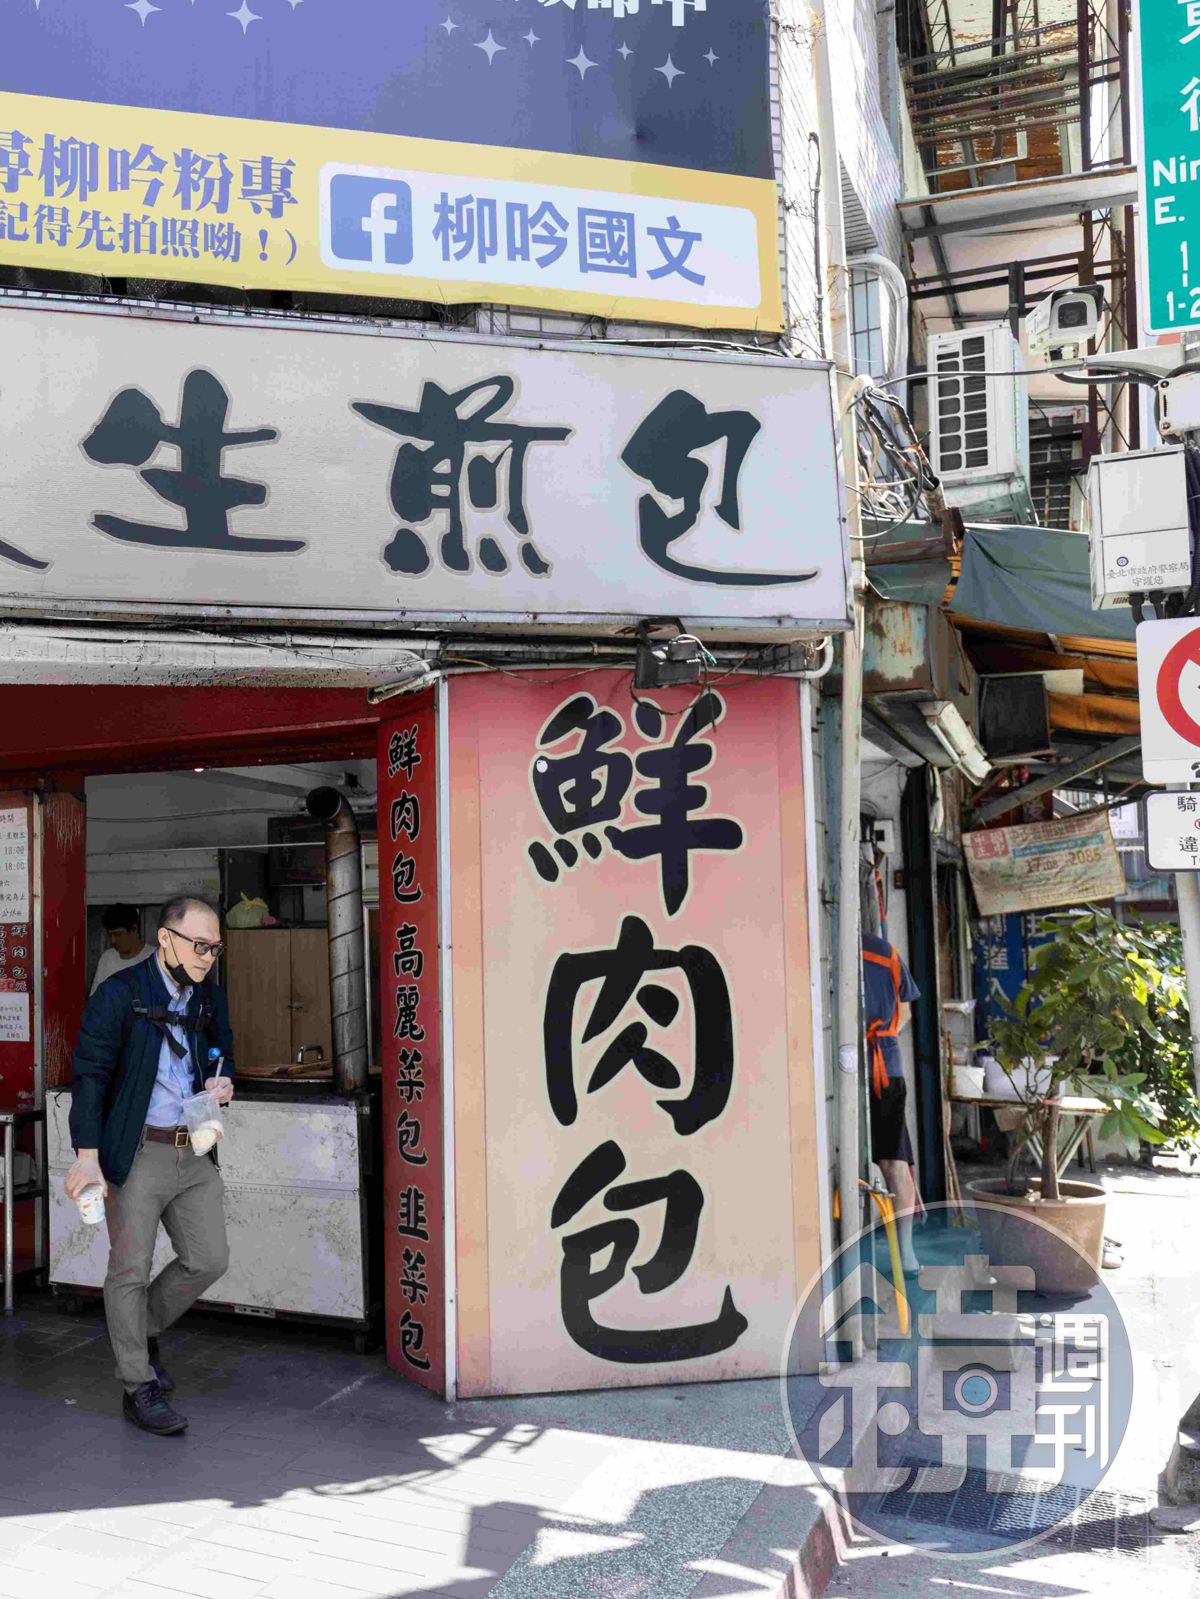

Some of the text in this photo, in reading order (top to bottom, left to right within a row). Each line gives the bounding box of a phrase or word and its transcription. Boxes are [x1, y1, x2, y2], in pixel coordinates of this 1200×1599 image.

[433, 192, 707, 286] 柳吟國文
[1154, 196, 1185, 225] E.
[388, 724, 431, 1372] 鮮肉包 高麗菜包 韭菜包
[527, 690, 750, 1366] 鮮肉包
